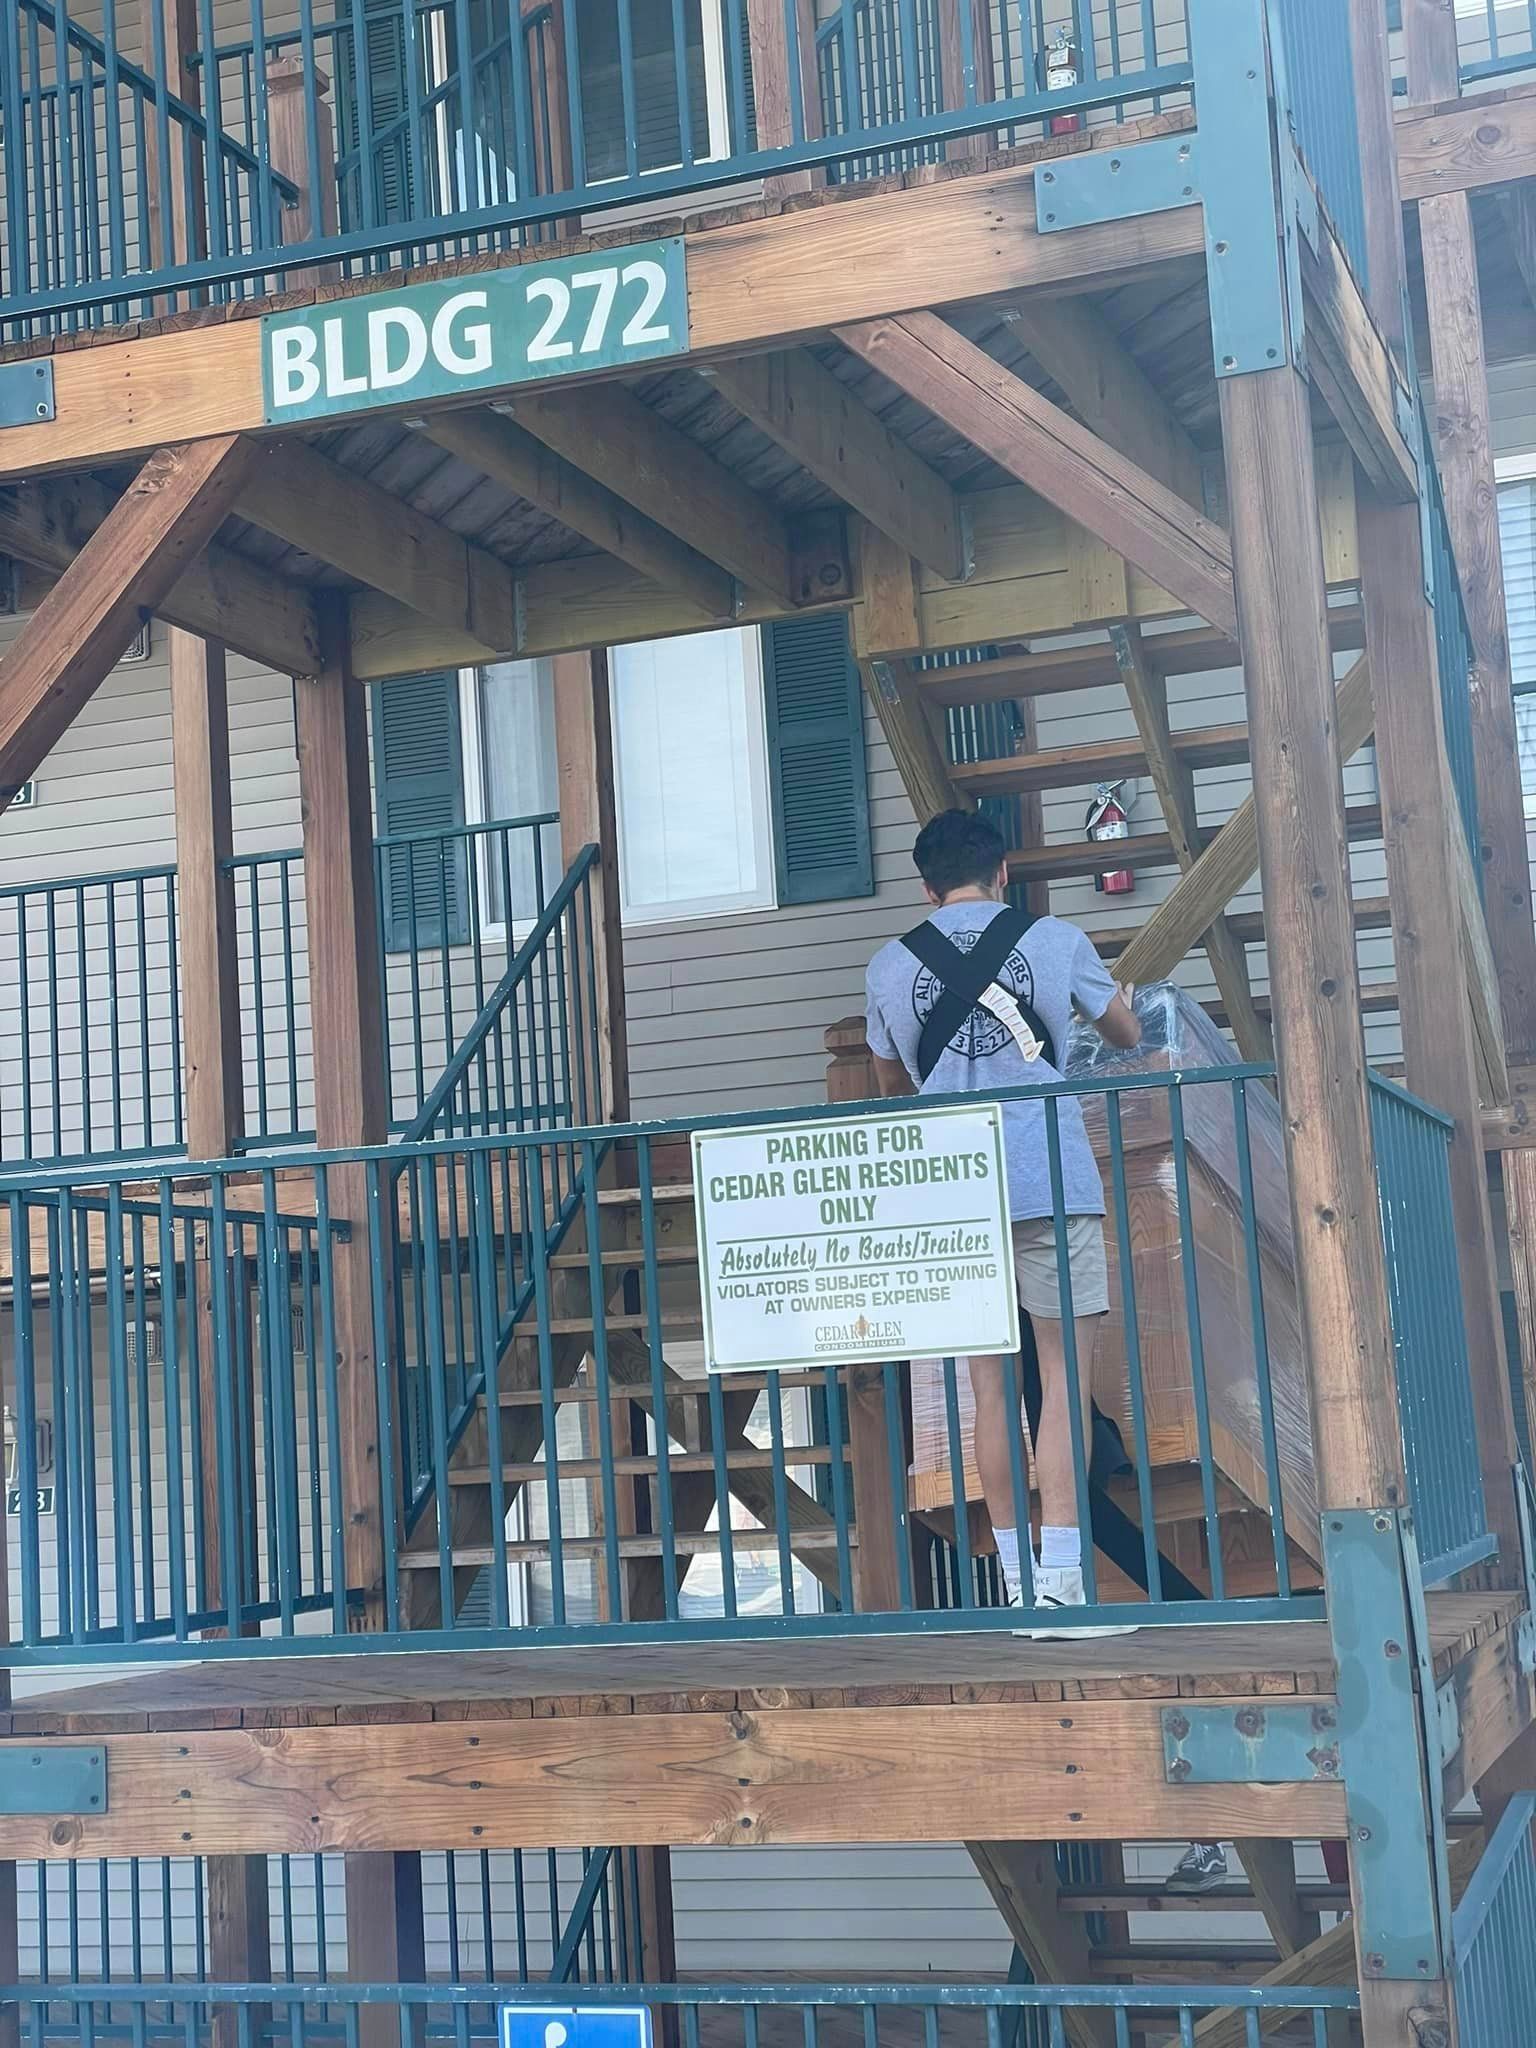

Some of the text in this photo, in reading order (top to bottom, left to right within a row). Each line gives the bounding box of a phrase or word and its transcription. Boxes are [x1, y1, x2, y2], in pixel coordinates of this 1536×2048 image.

[271, 260, 670, 408] BLDG 272
[916, 975, 933, 1000] ALL
[766, 1124, 923, 1164] PARKING FOR
[710, 1152, 989, 1203] CEDAR GLEN RESIDENTS
[820, 1195, 877, 1225] ONLY
[720, 1228, 990, 1276] Absolutely No Boats/Trailers
[717, 1263, 997, 1300] VIOLATORS SUBJECT TO TOWING
[764, 1286, 951, 1315] AT OWNERS EXPENSE
[815, 1321, 902, 1342] CEDAR GLEN
[815, 1338, 905, 1351] CONDOMINIUMS
